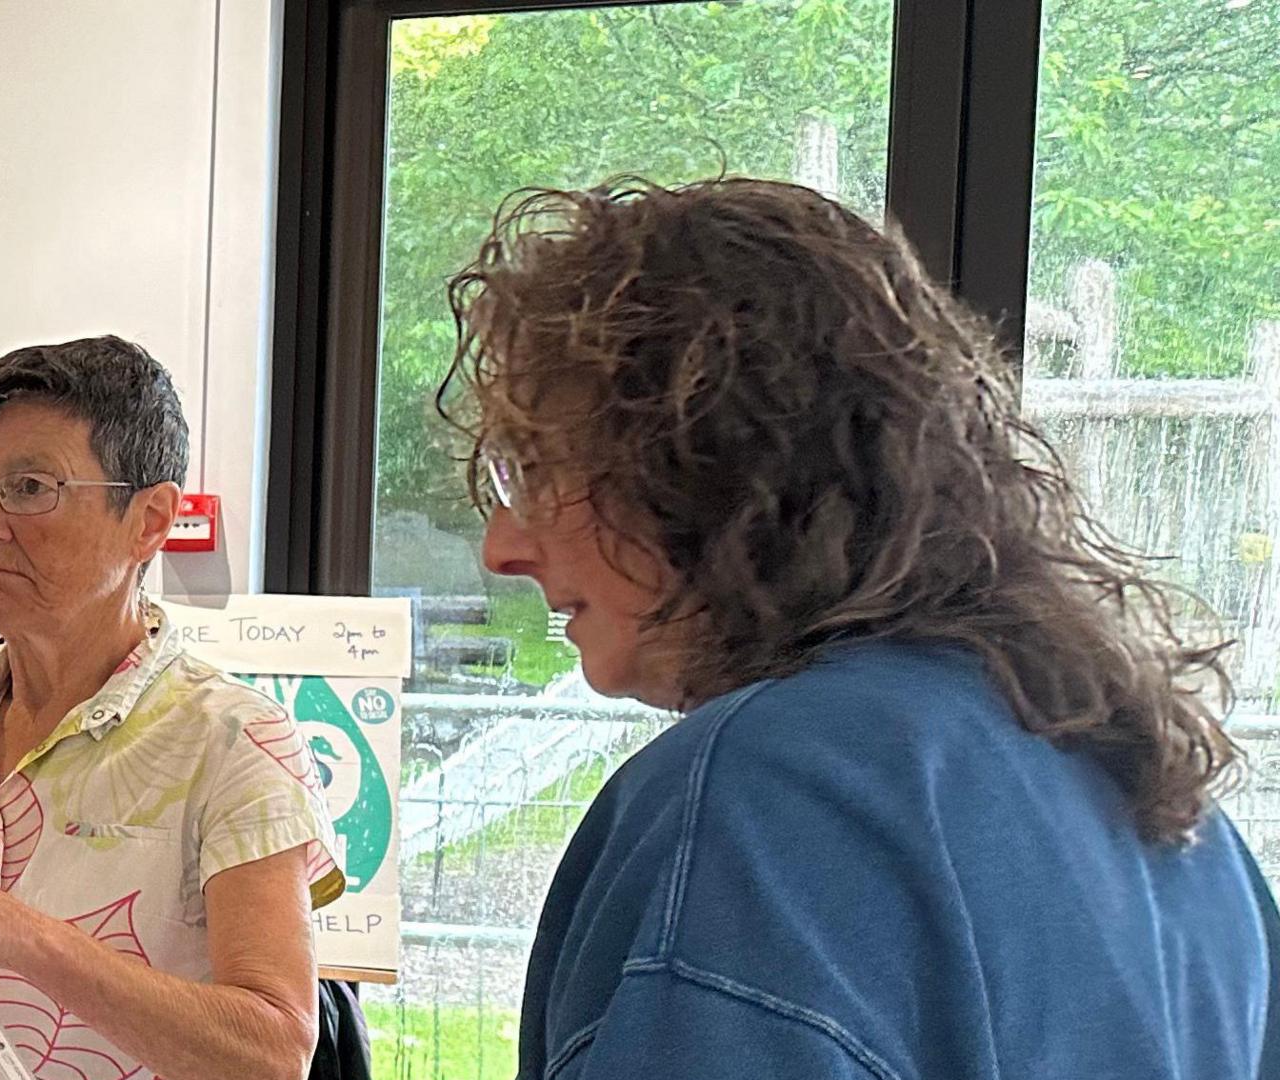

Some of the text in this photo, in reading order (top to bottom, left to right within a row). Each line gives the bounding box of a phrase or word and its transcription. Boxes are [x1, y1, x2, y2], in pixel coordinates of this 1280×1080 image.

[182, 626, 218, 642] RE
[372, 626, 386, 638] to
[358, 694, 386, 712] NO
[312, 912, 382, 934] HELP
